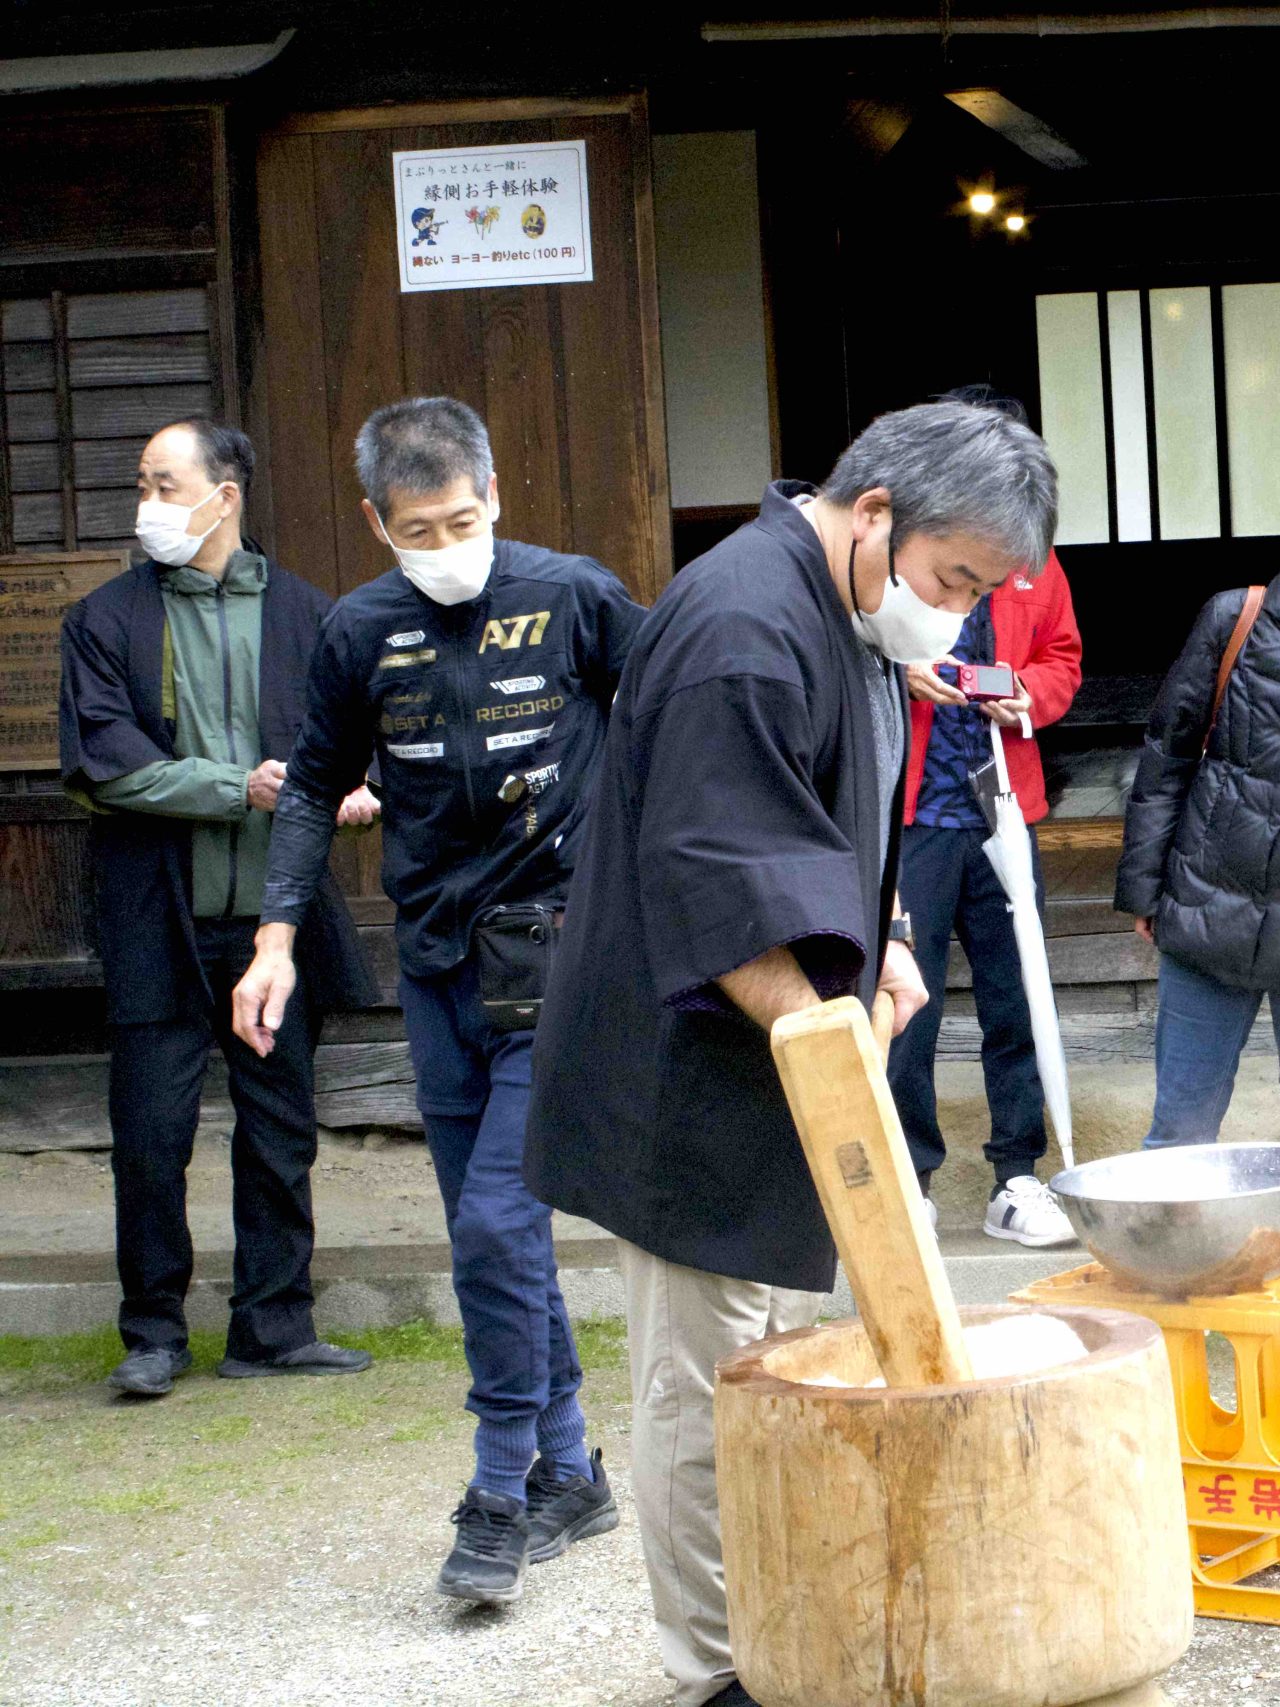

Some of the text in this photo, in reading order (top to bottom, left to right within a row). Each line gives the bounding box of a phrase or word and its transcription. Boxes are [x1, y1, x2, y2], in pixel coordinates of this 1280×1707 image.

[404, 160, 527, 178] まぶりっとさんと一緒に
[423, 176, 559, 202] 縁側お手軽体験
[479, 610, 551, 654] A77
[394, 695, 564, 731] SET A RECORD
